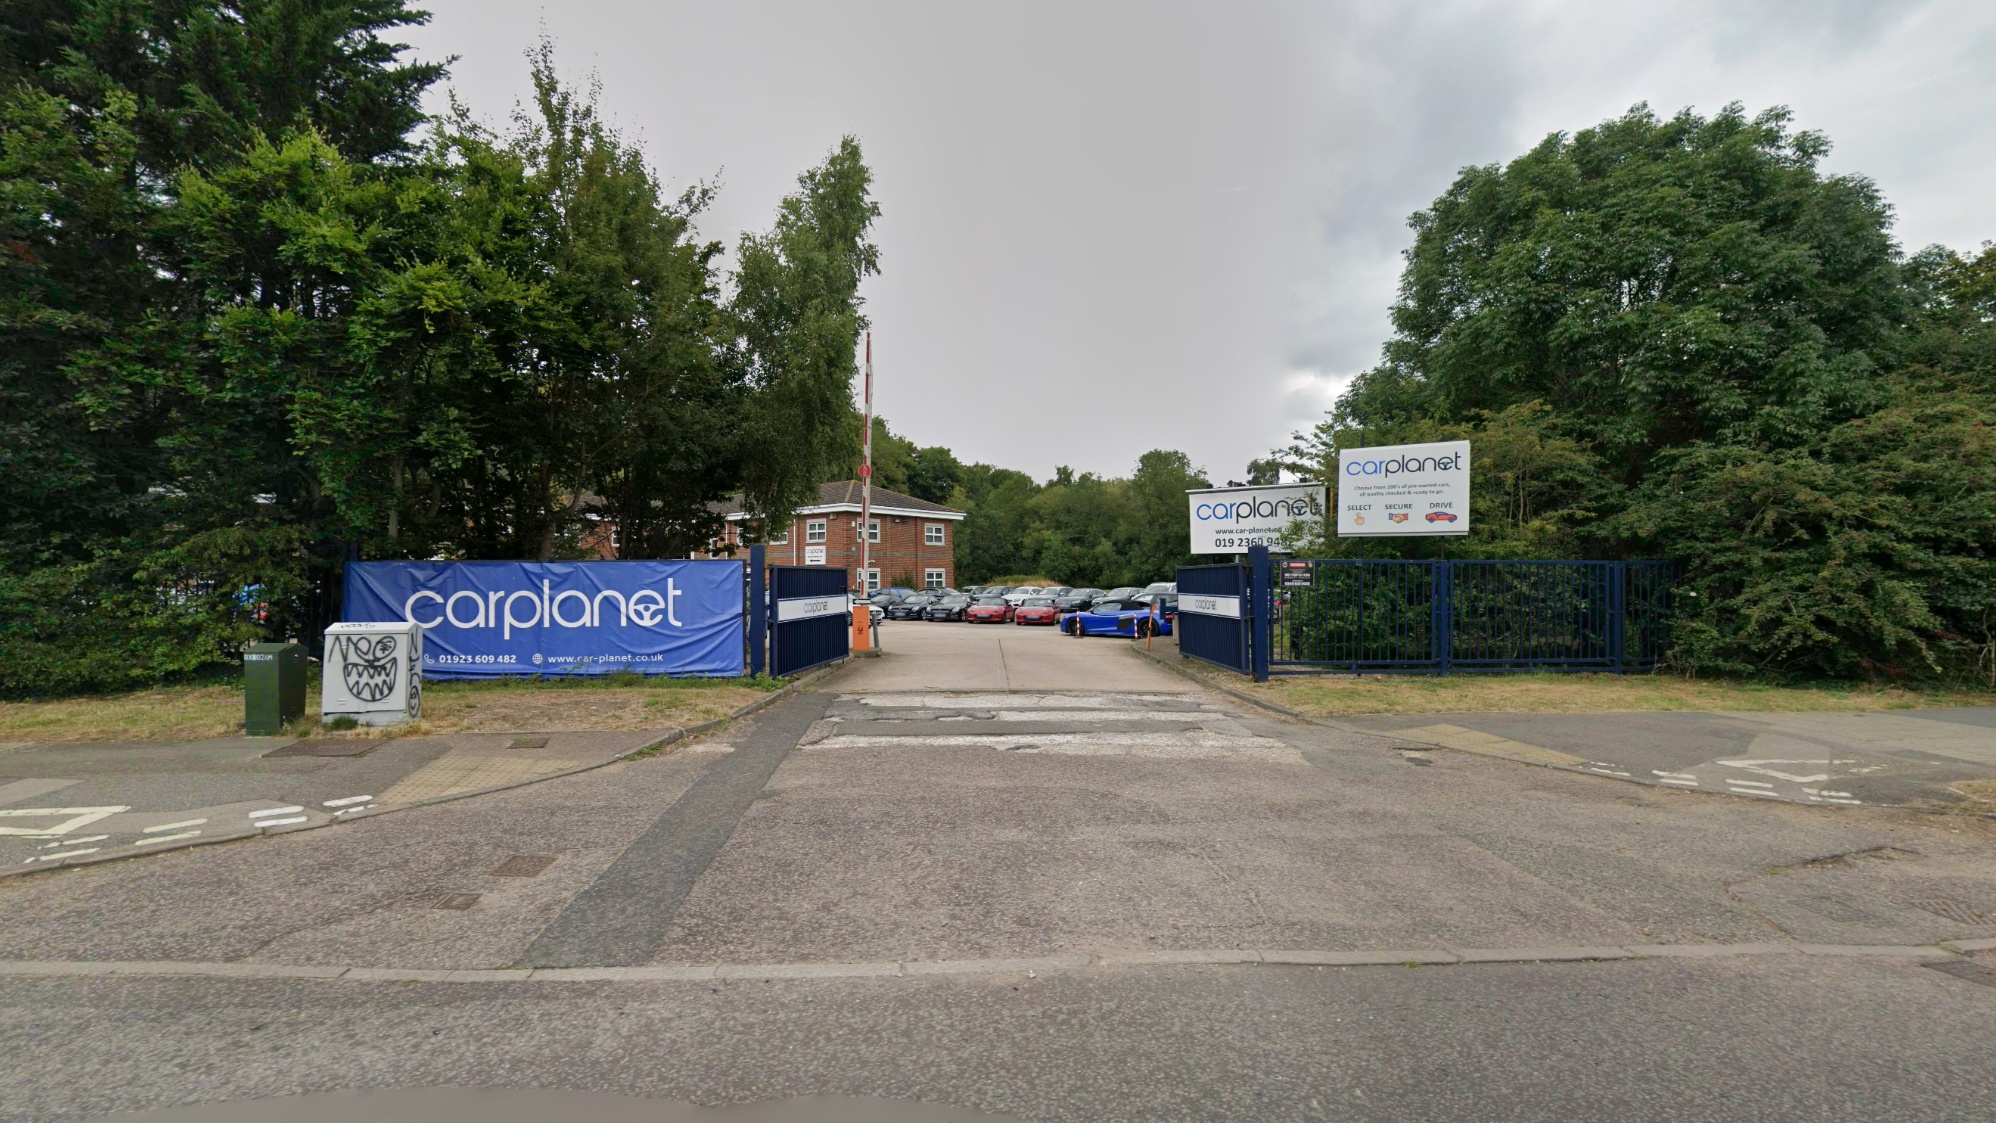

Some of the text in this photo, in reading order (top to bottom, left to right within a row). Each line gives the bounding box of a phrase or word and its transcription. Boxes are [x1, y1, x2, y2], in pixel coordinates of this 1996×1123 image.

[1346, 451, 1461, 478] carplanet
[1408, 482, 1437, 490] pre-owned
[1429, 501, 1454, 509] DRIVE
[1215, 538, 1234, 547] 019
[1237, 537, 1264, 547] 2360
[404, 577, 682, 640] carplanet
[438, 653, 517, 664] 01923 609 482
[547, 652, 664, 665] www.car-planet.co.uk
